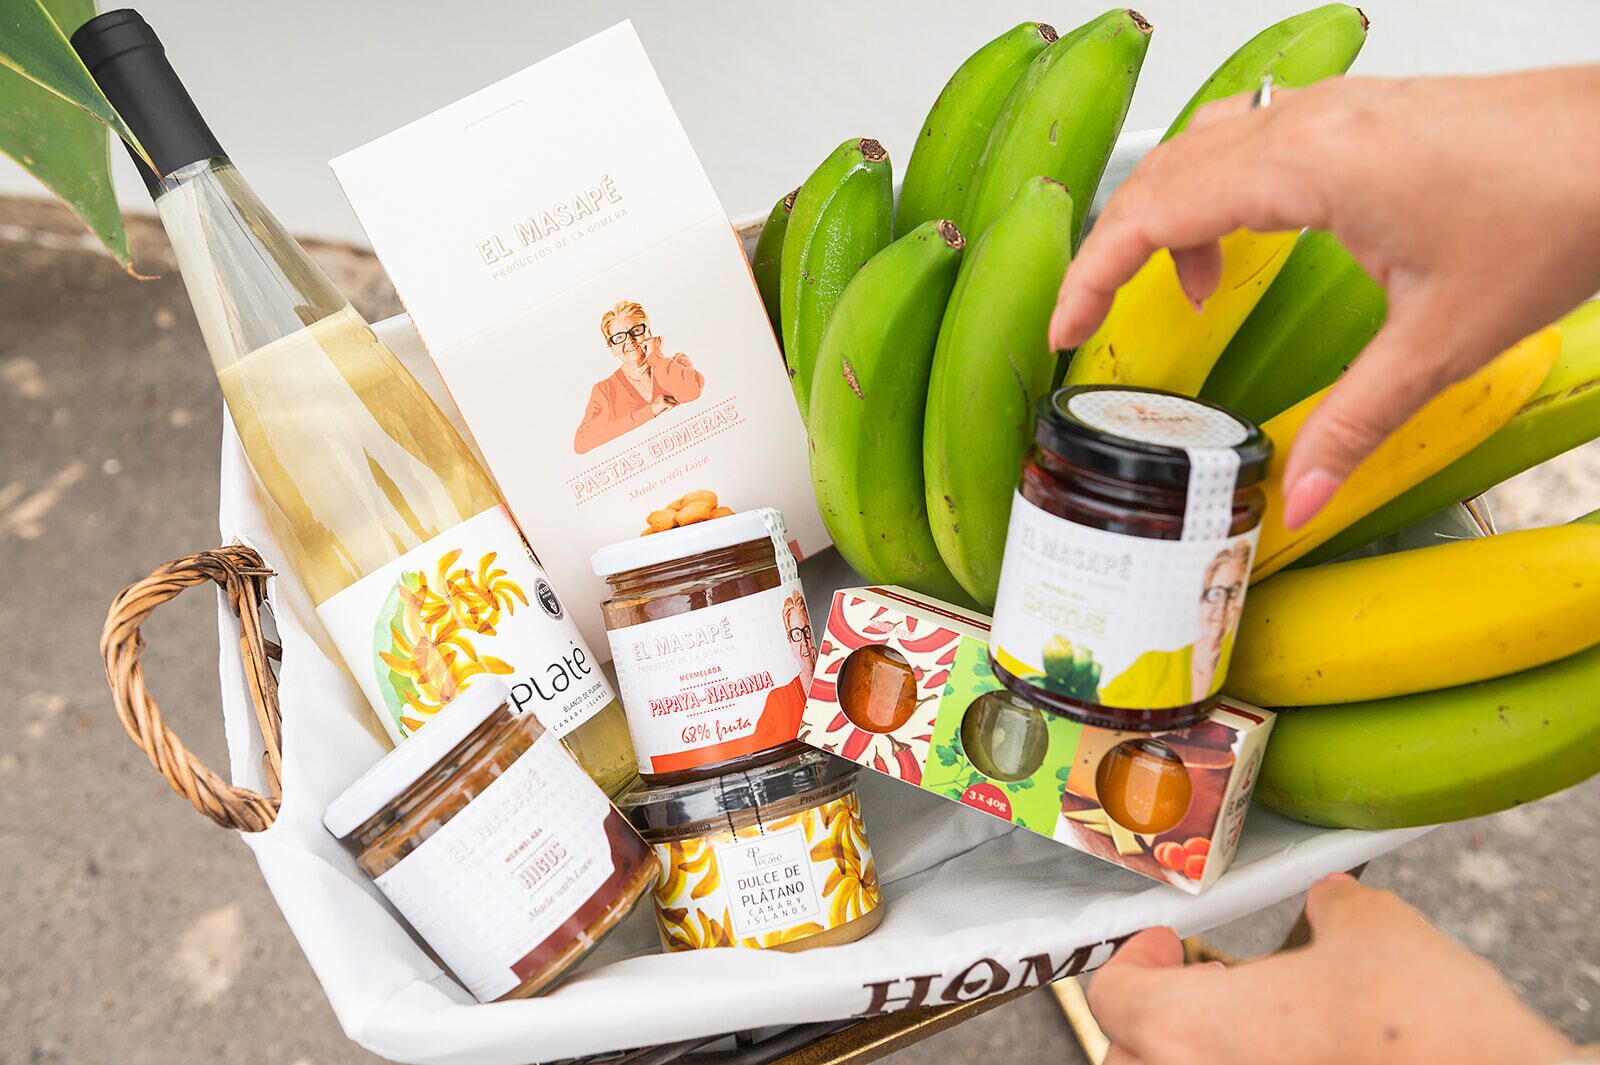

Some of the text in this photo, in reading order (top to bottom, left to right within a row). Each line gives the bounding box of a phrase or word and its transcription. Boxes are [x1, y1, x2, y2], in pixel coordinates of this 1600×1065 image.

[476, 174, 623, 265] EL MASAPÉ
[492, 208, 629, 280] PRODUCTOS DE LA GOMERA
[570, 404, 740, 499] PASTAS GOMERAS
[628, 455, 710, 502] Made with Love
[632, 617, 734, 662] EL MASAPÉ
[679, 665, 722, 682] MERMELADA
[563, 697, 583, 712] BLANCO
[582, 691, 589, 700] DE
[648, 670, 774, 717] PAPAYA-NARANJA
[553, 690, 607, 731] CANARY ISLANDS
[681, 716, 752, 744] 68% fruta
[969, 790, 1007, 812] 3 x 40g
[738, 864, 801, 891] DULCE DE
[741, 880, 805, 907] PLÁTANO
[749, 897, 801, 917] CANARY
[748, 904, 807, 925] ISLANDS
